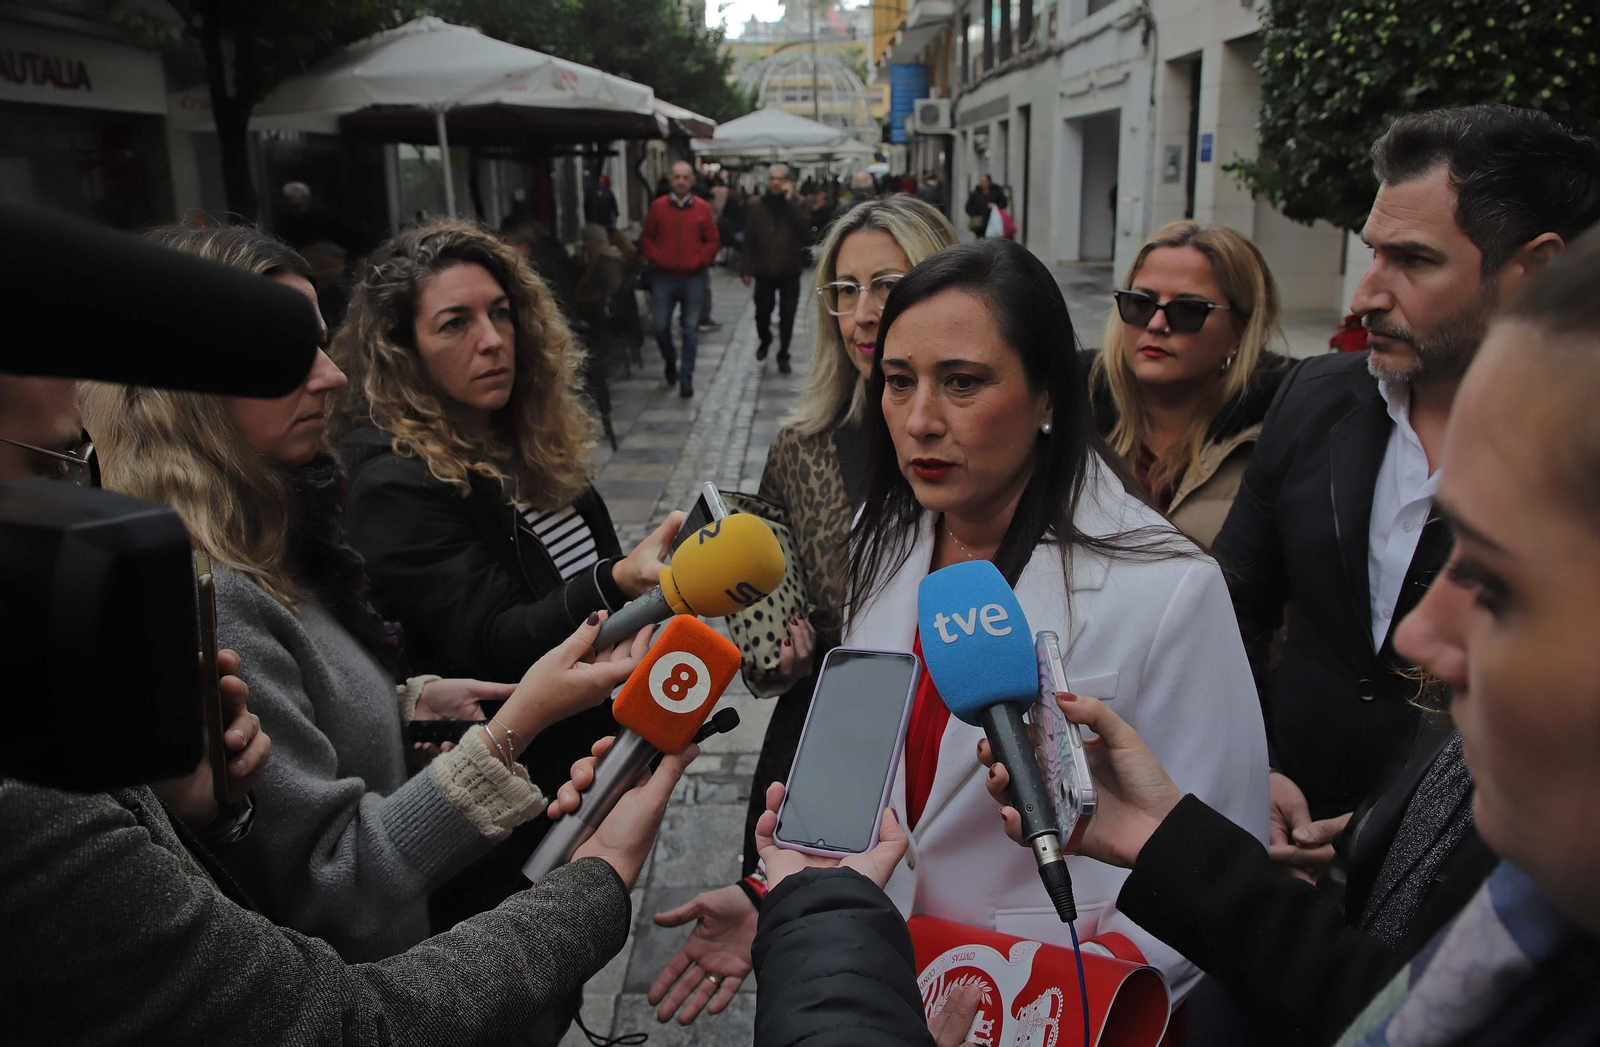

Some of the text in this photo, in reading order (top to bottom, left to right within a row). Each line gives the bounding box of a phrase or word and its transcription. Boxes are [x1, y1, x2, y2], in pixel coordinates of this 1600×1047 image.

[933, 603, 1013, 644] tve
[662, 662, 698, 701] 8
[951, 951, 976, 964] CIVITAS
